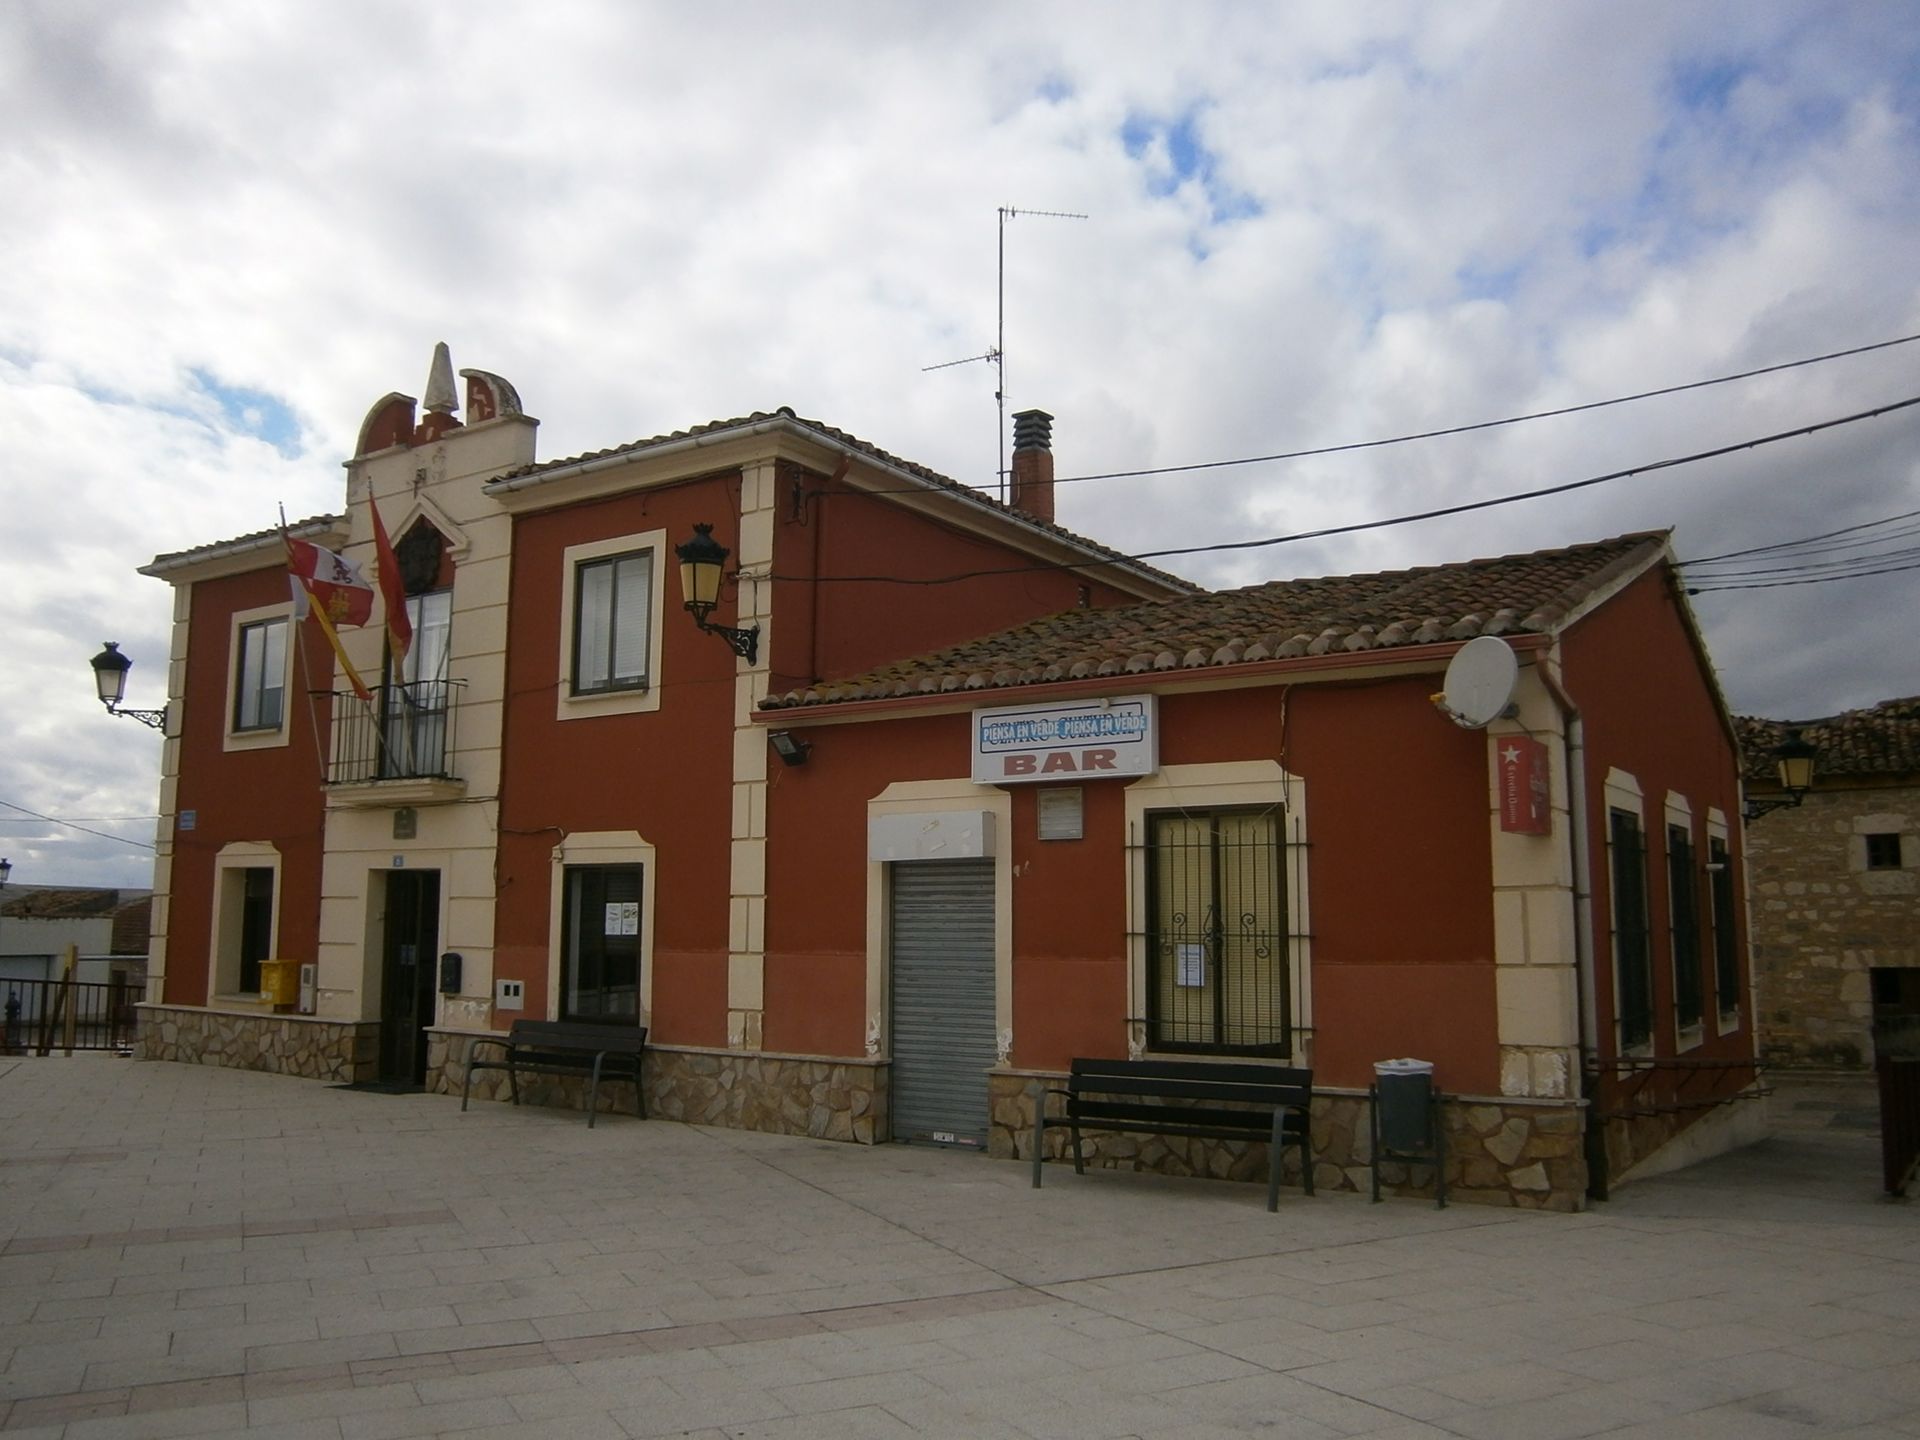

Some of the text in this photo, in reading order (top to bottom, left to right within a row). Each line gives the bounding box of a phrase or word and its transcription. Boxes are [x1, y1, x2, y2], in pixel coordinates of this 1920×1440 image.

[984, 726, 1016, 742] PIENSA
[1017, 725, 1029, 739] EN
[1030, 721, 1060, 737] VERDE
[1064, 719, 1100, 735] PIENSA
[1100, 718, 1113, 732] EN
[1115, 715, 1146, 731] VERDE
[1004, 749, 1117, 776] BAR
